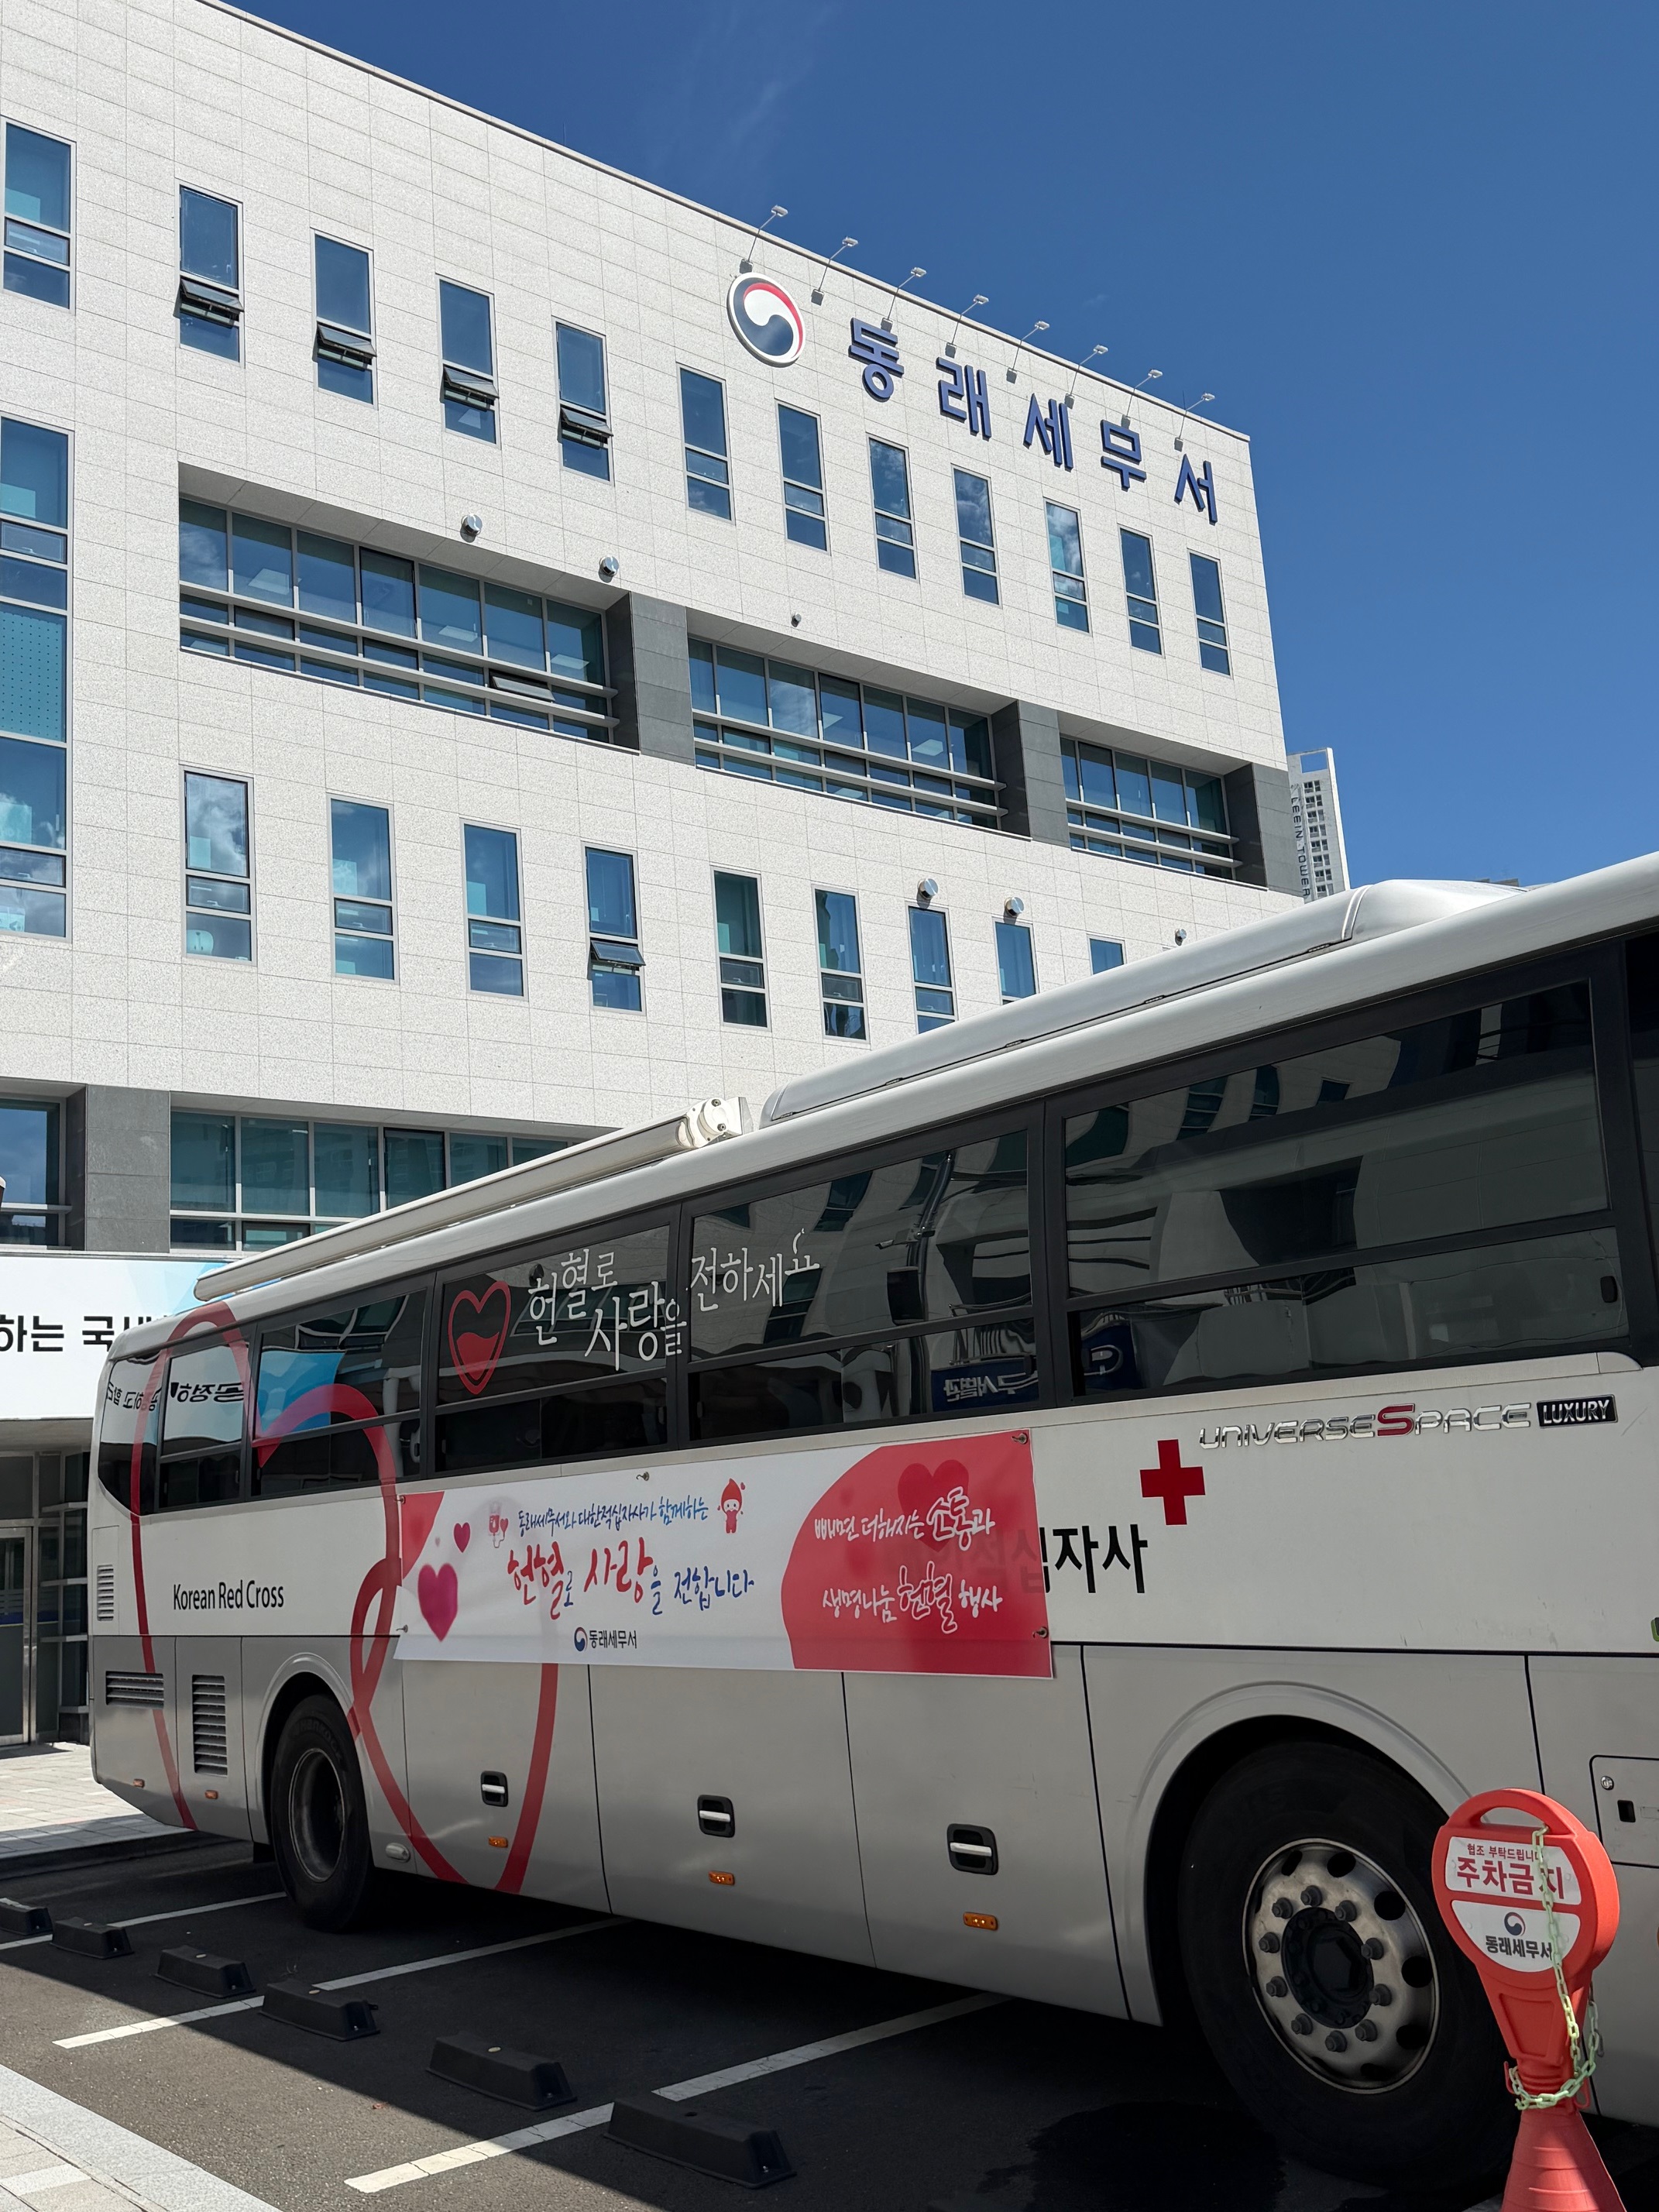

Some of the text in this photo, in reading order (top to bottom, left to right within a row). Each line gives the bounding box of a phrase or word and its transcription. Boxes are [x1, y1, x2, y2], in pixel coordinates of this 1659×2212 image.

[848, 317, 1218, 525] 동래세무서
[1297, 846, 1310, 897] TOWER
[527, 1249, 619, 1345] 헌혈로
[584, 1228, 821, 1371] 사랑을 전하세요
[1541, 1399, 1611, 1425] LUXURY
[518, 1495, 709, 1537] 동래세무서와 대한적십자사가 함께하는
[861, 1507, 925, 1542] 더해지는
[173, 1580, 284, 1611] Korean Red Cross
[507, 1537, 755, 1620] 헌혈로 사랑을 전합니다
[823, 1561, 1003, 1633] 생명나눔 헌혈 행사
[589, 1630, 637, 1650] 동래세무서
[1467, 1843, 1485, 1856] 협조
[1457, 1857, 1565, 1899] 주차금지
[1486, 1936, 1552, 1961] 동래세무서
